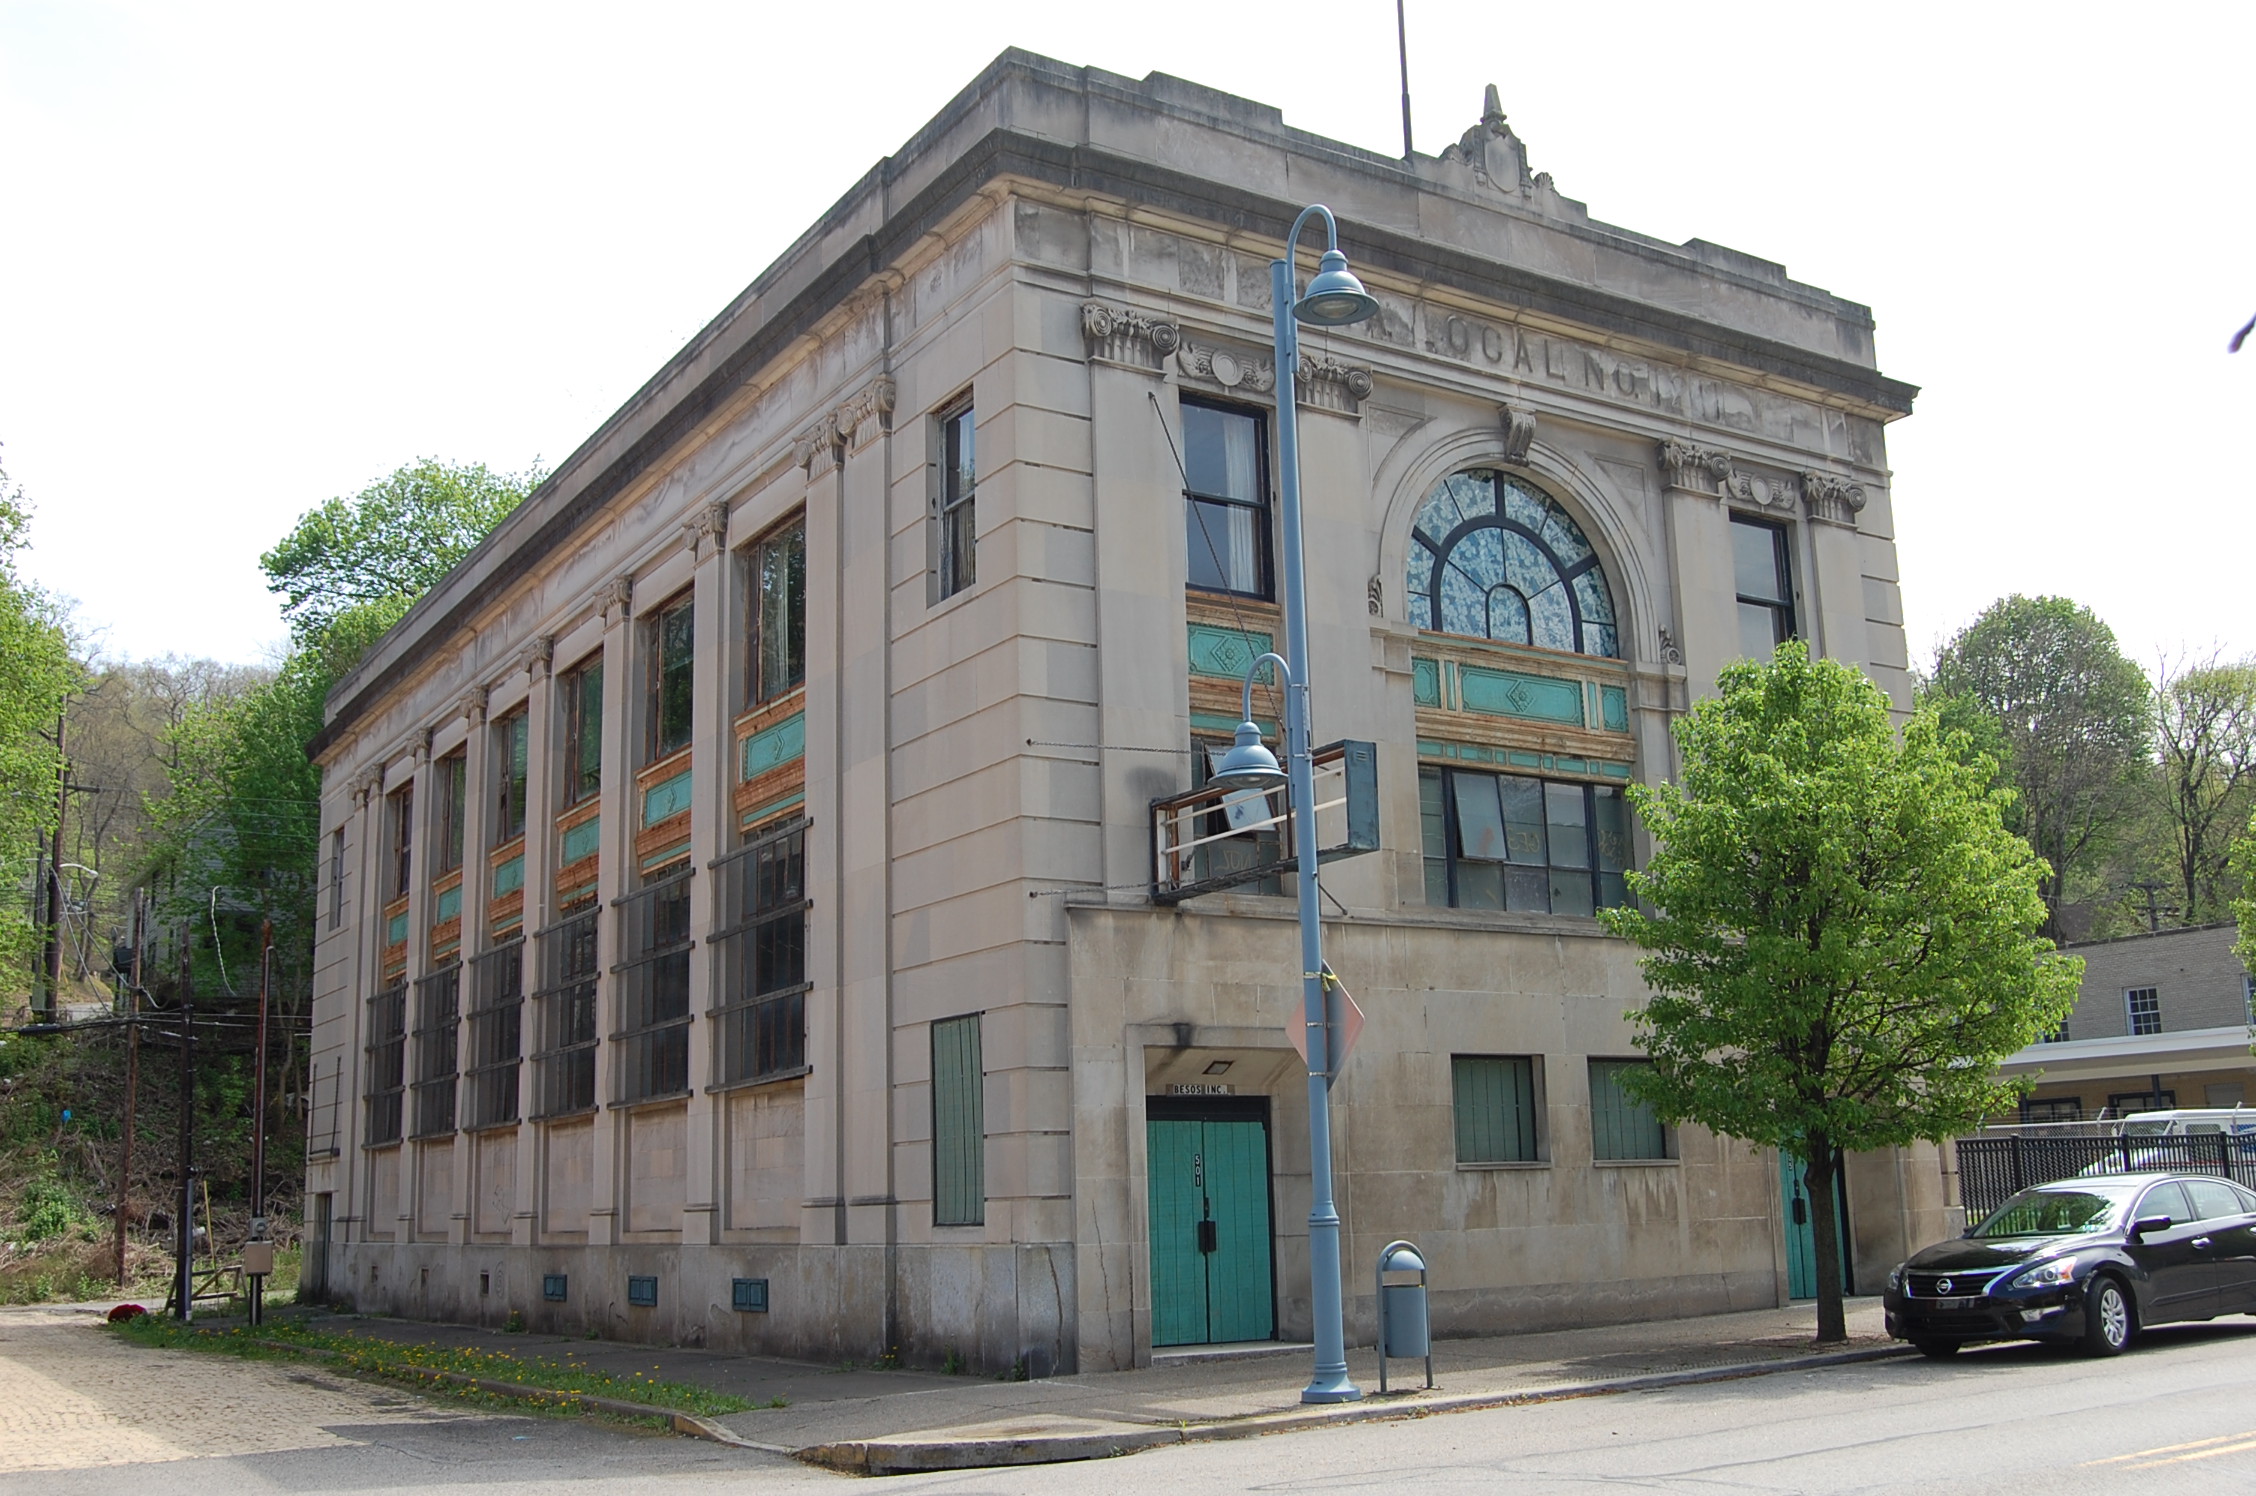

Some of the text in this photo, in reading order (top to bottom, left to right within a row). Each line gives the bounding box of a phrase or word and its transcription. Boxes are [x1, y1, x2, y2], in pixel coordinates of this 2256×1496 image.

[1428, 314, 1565, 382] OCAL
[1174, 1084, 1226, 1094] BESOS INC.
